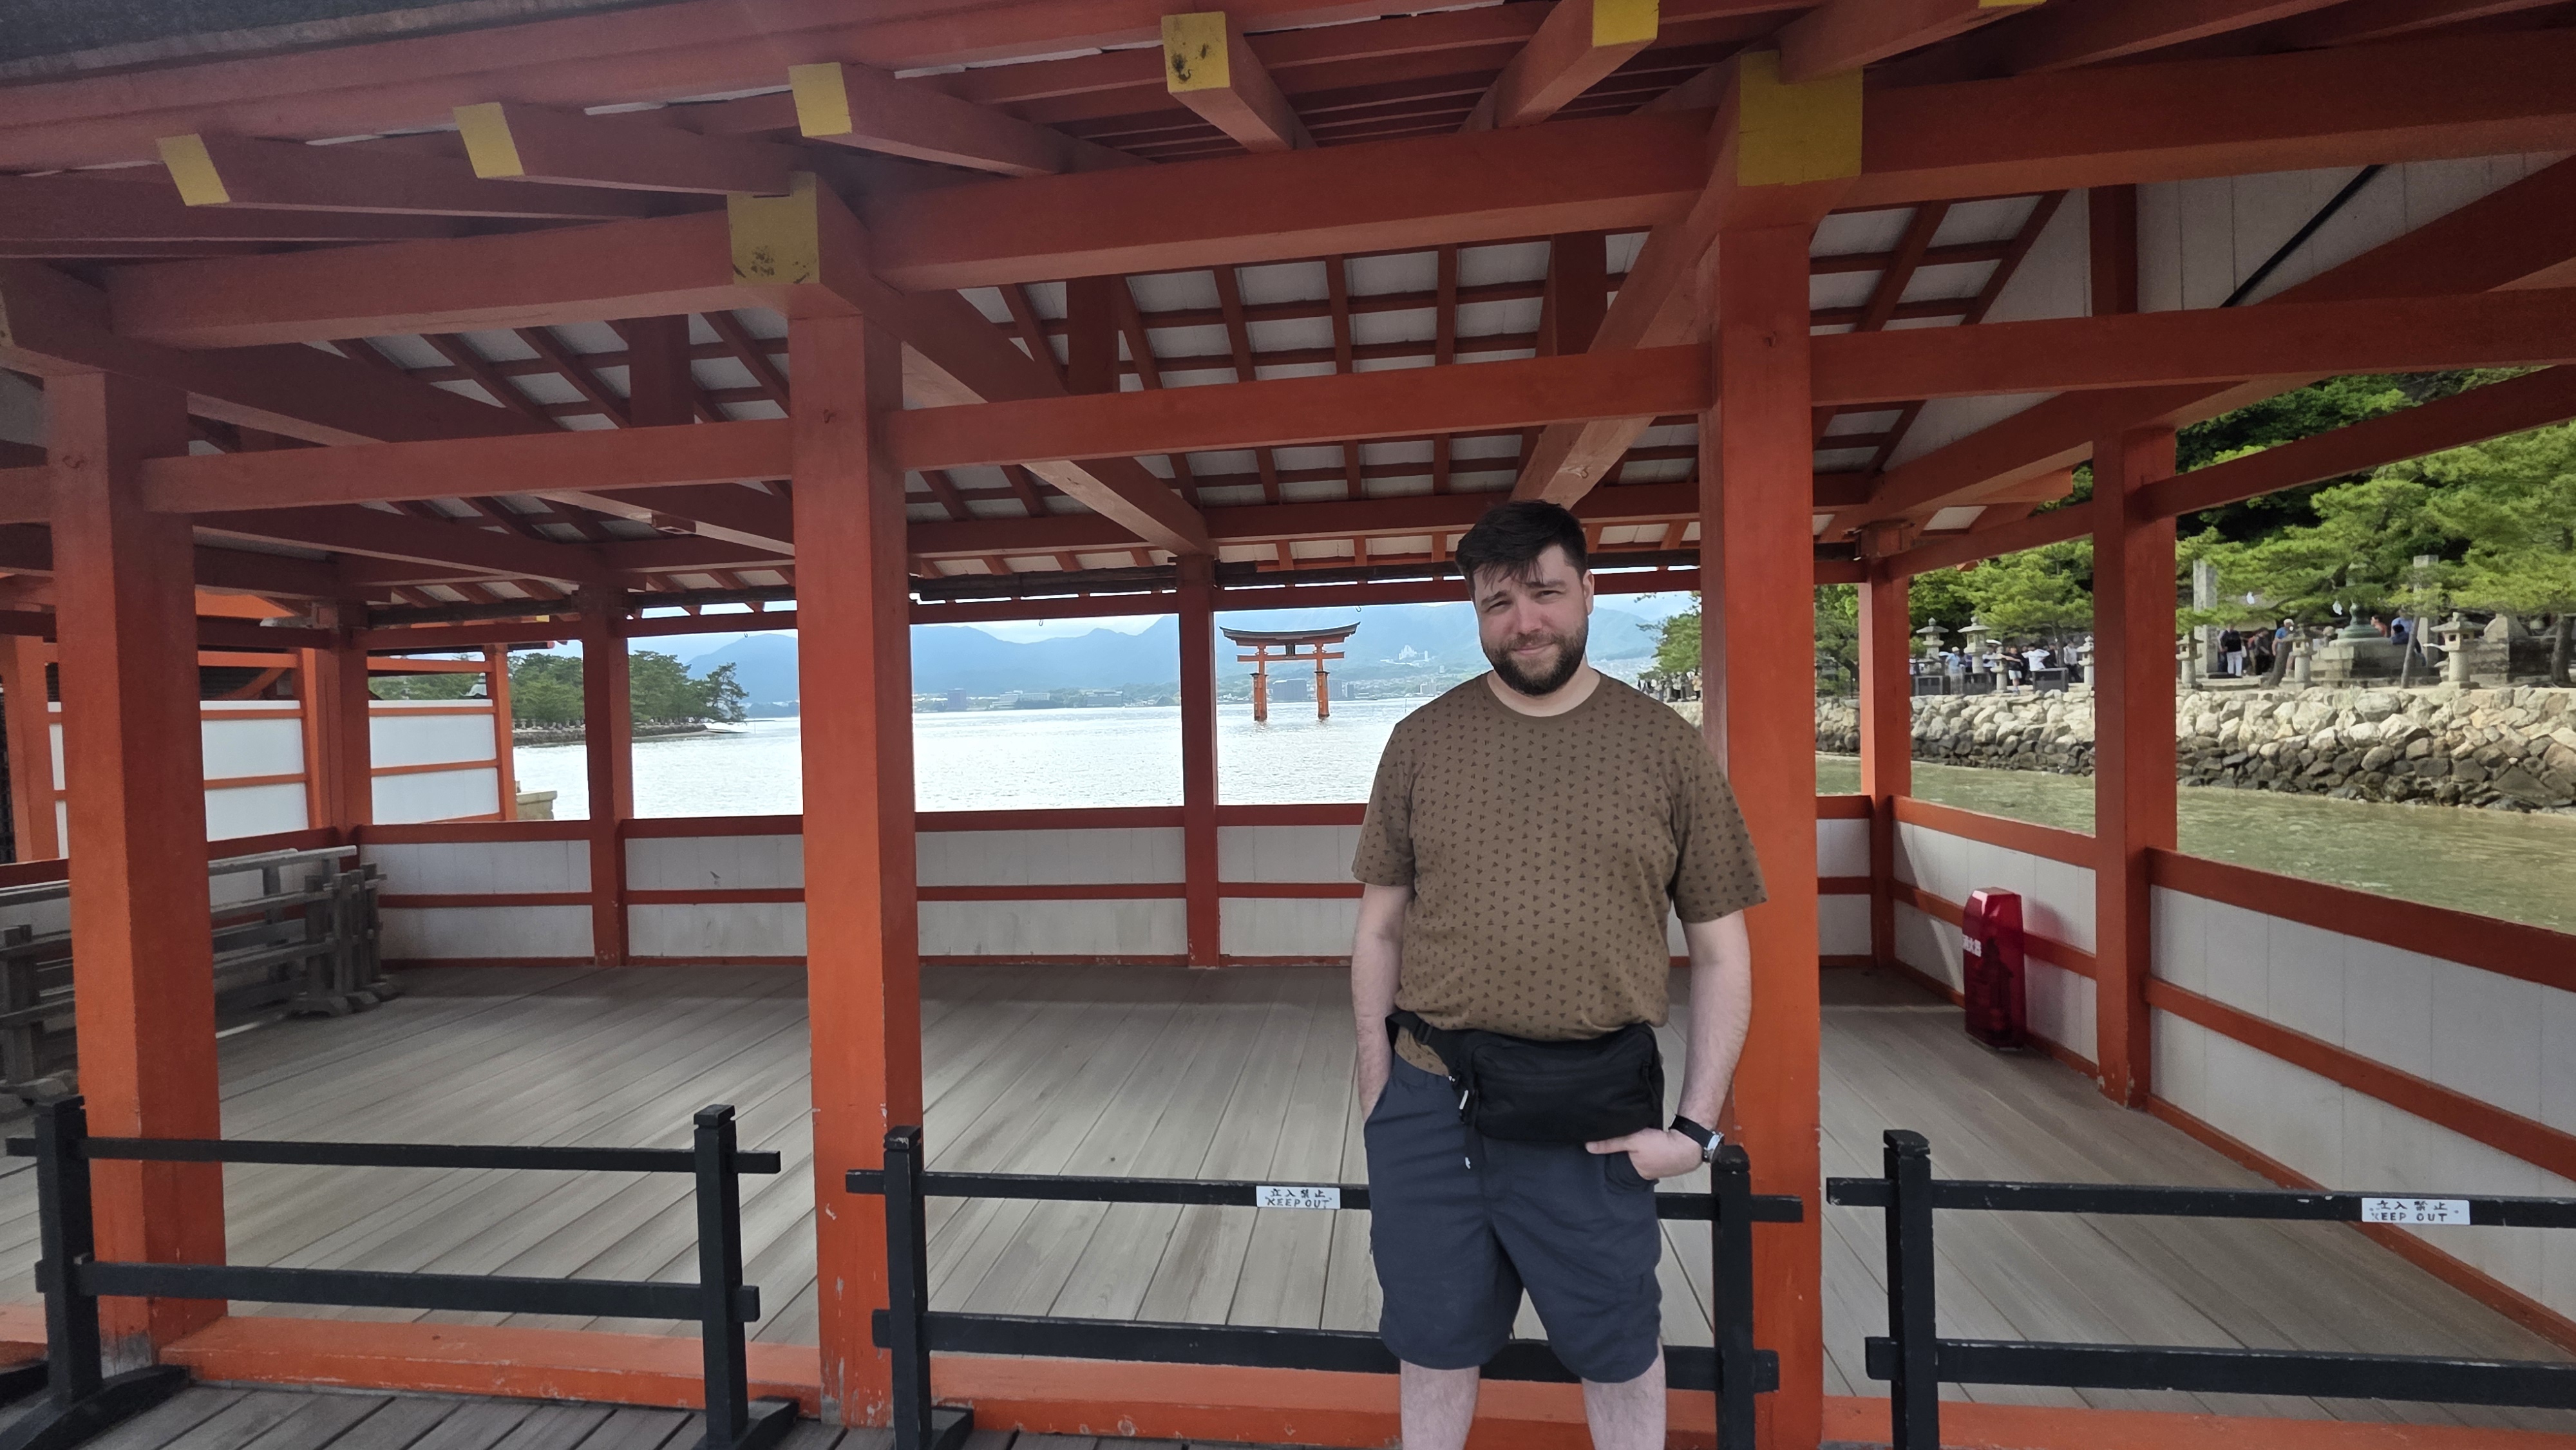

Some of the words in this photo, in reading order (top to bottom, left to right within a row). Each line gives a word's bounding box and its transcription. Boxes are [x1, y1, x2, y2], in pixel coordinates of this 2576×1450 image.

[1270, 1188, 1326, 1198] 立入禁止
[1265, 1196, 1301, 1207] KEEP
[1305, 1199, 1330, 1209] OUT
[2376, 1200, 2448, 1211] 立入禁止
[2371, 1212, 2407, 1221] KEEP
[2416, 1213, 2448, 1222] OUT
